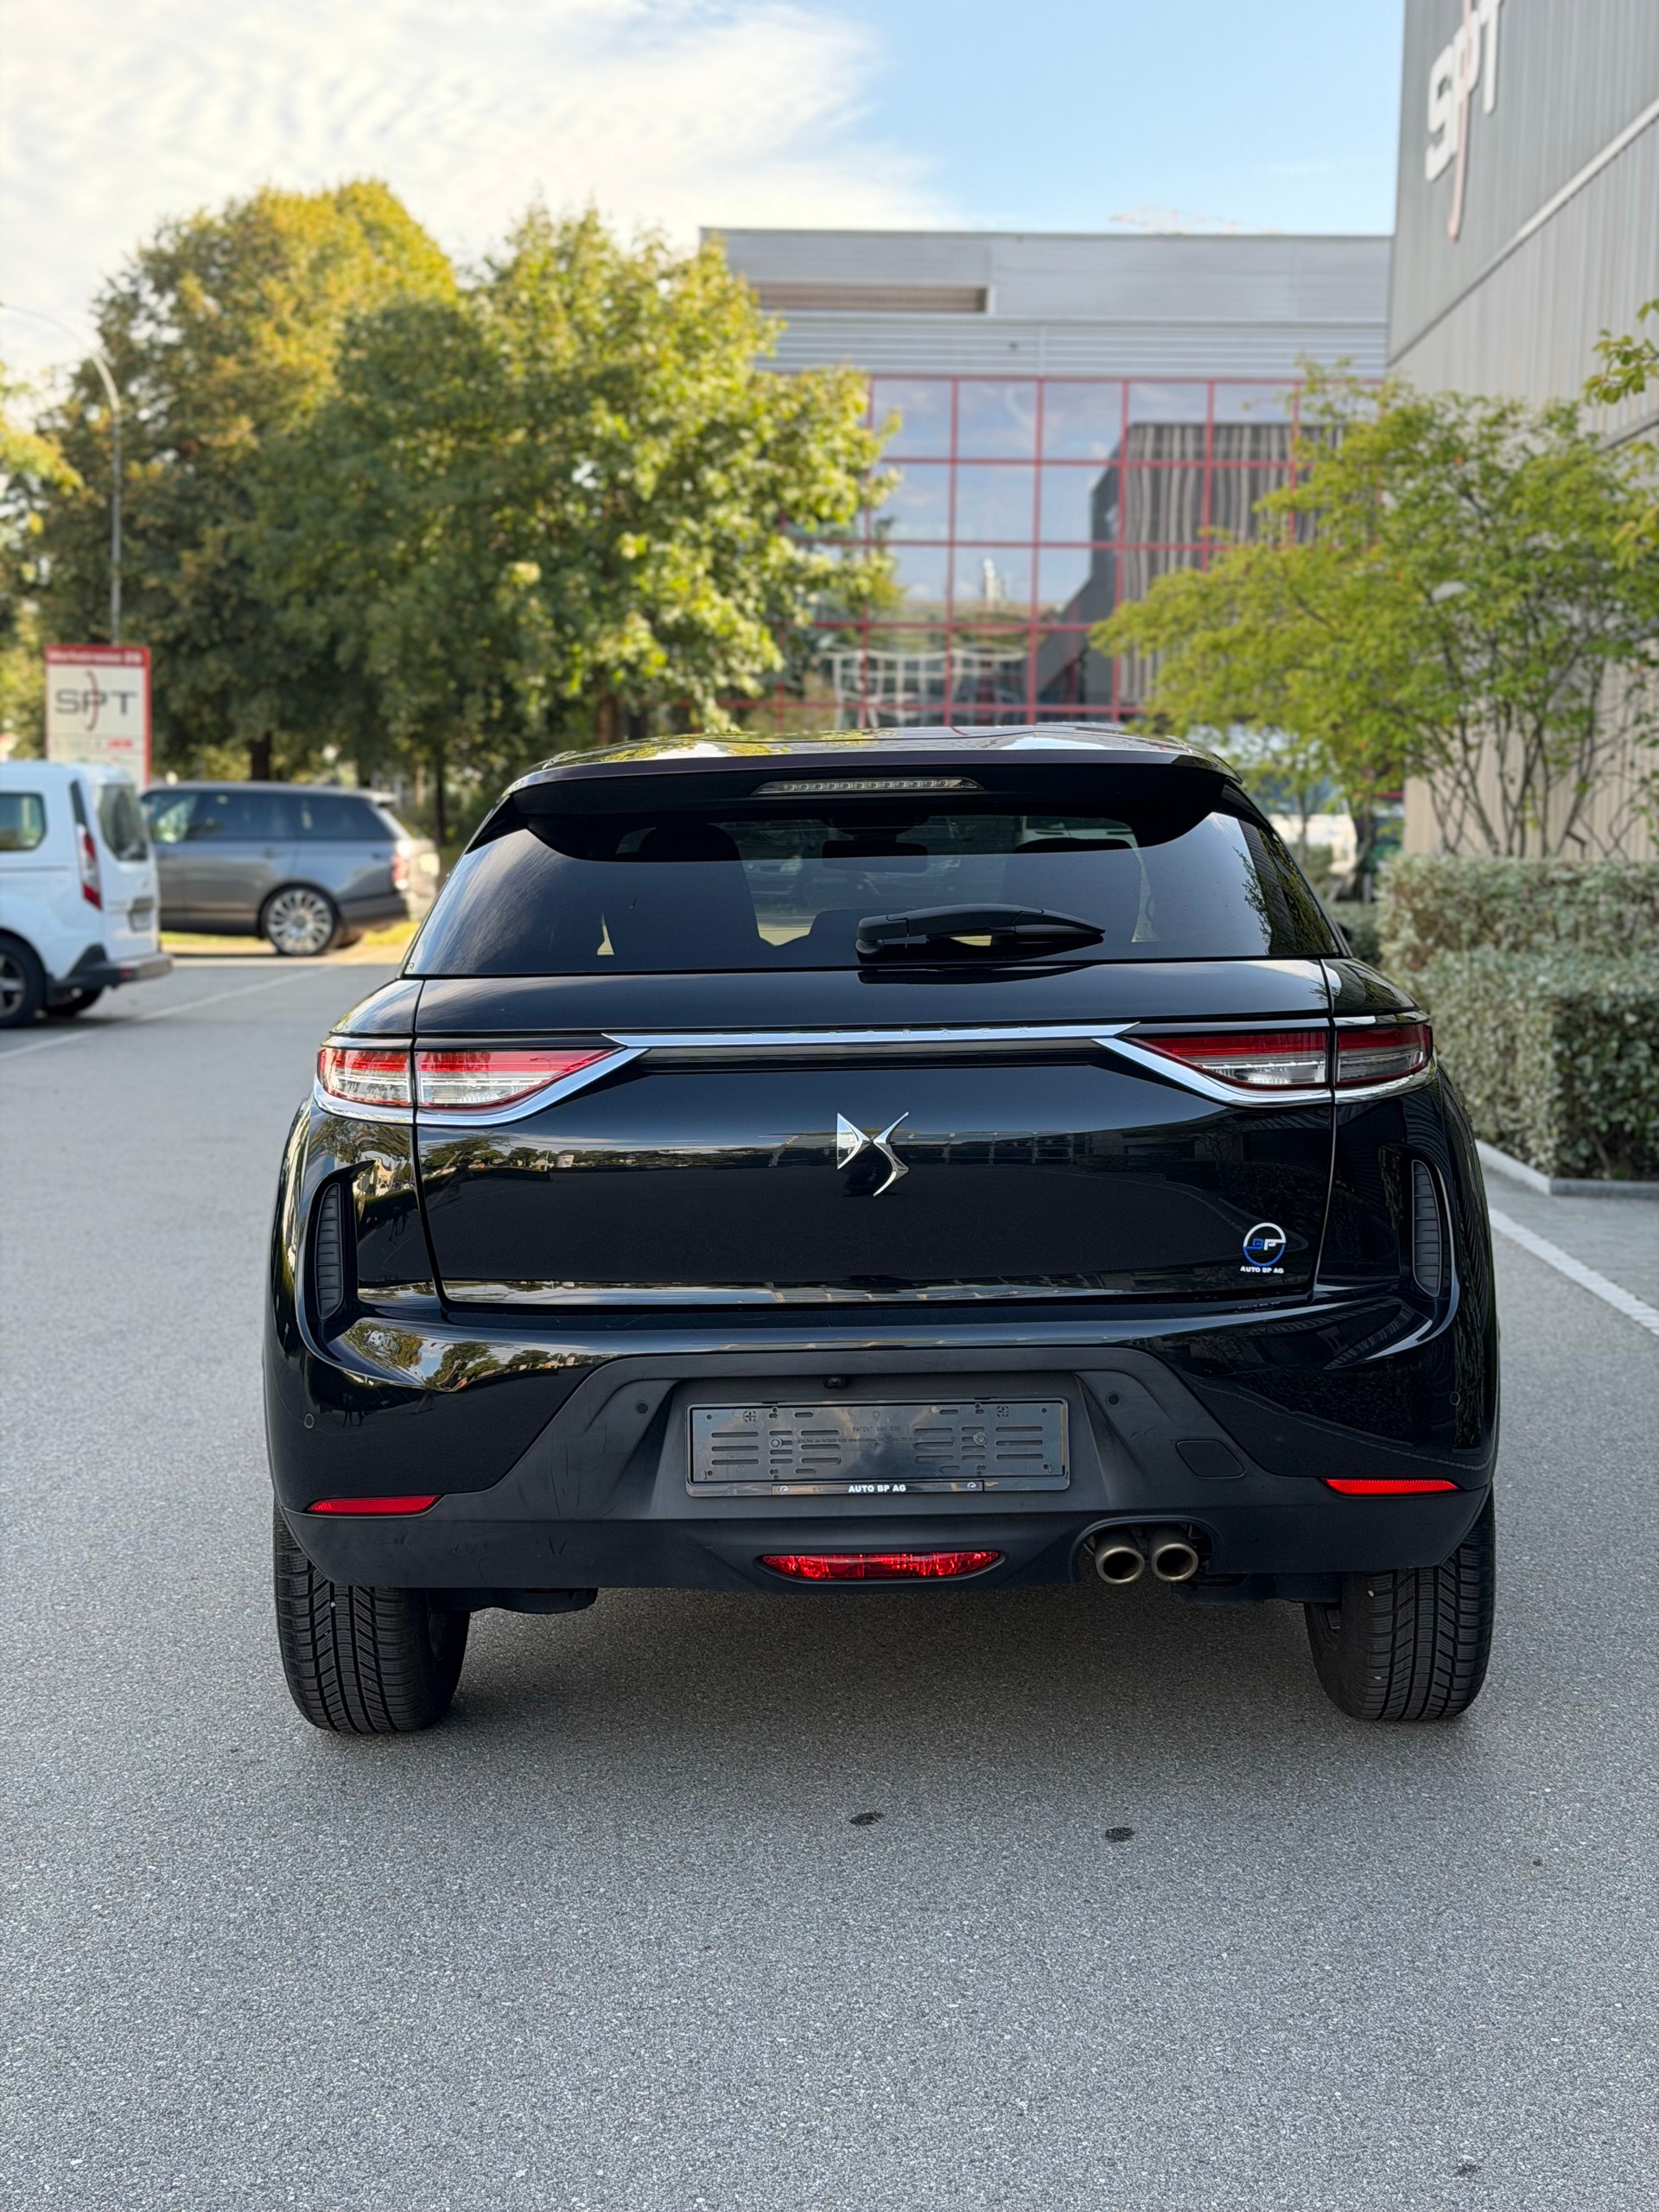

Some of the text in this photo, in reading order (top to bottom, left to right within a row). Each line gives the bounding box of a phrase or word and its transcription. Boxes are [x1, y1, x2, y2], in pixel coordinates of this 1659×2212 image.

[55, 688, 139, 716] SPT
[848, 1484, 874, 1493] AUTO
[892, 1484, 906, 1492] AG
